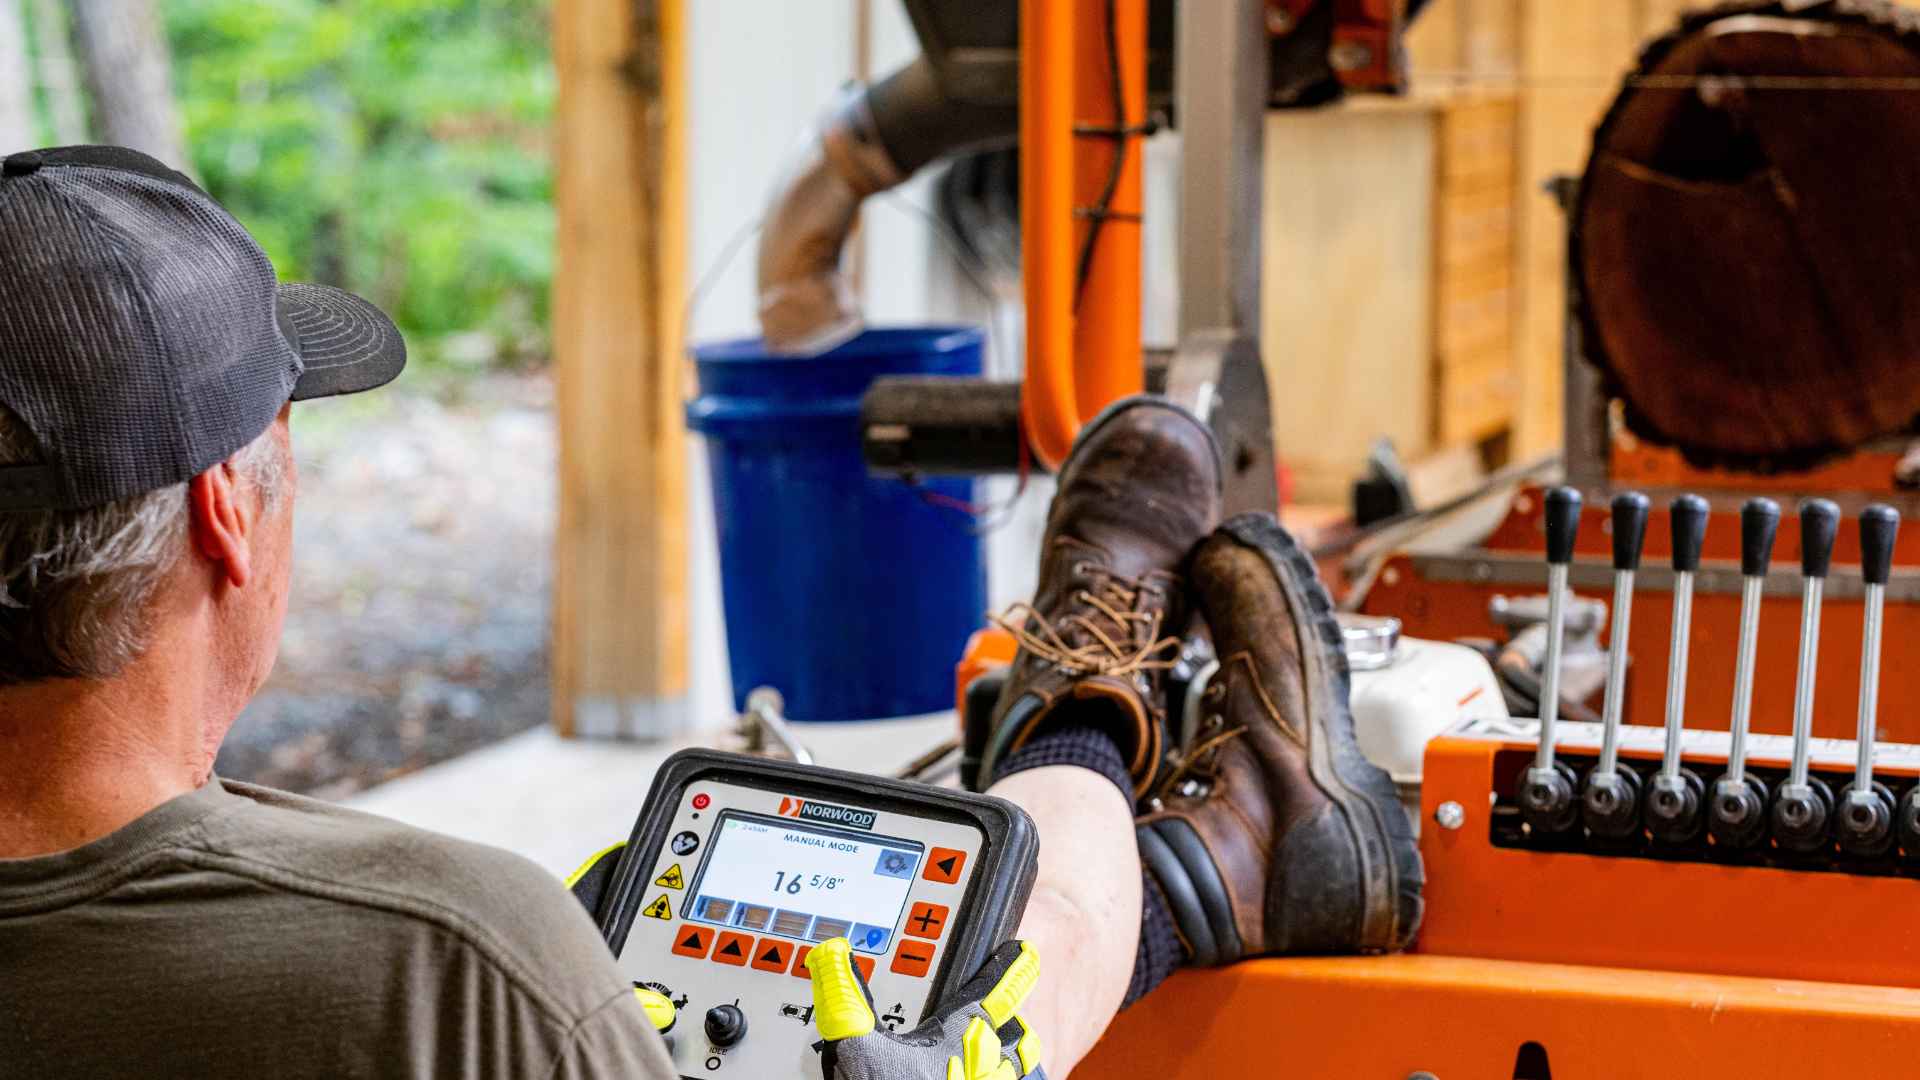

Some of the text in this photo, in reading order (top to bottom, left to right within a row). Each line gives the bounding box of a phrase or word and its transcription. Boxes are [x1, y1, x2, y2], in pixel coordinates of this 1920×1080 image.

[802, 803, 874, 825] NORWOOD
[783, 833, 860, 853] MANUAL MODE
[774, 871, 844, 894] 16 5/8"
